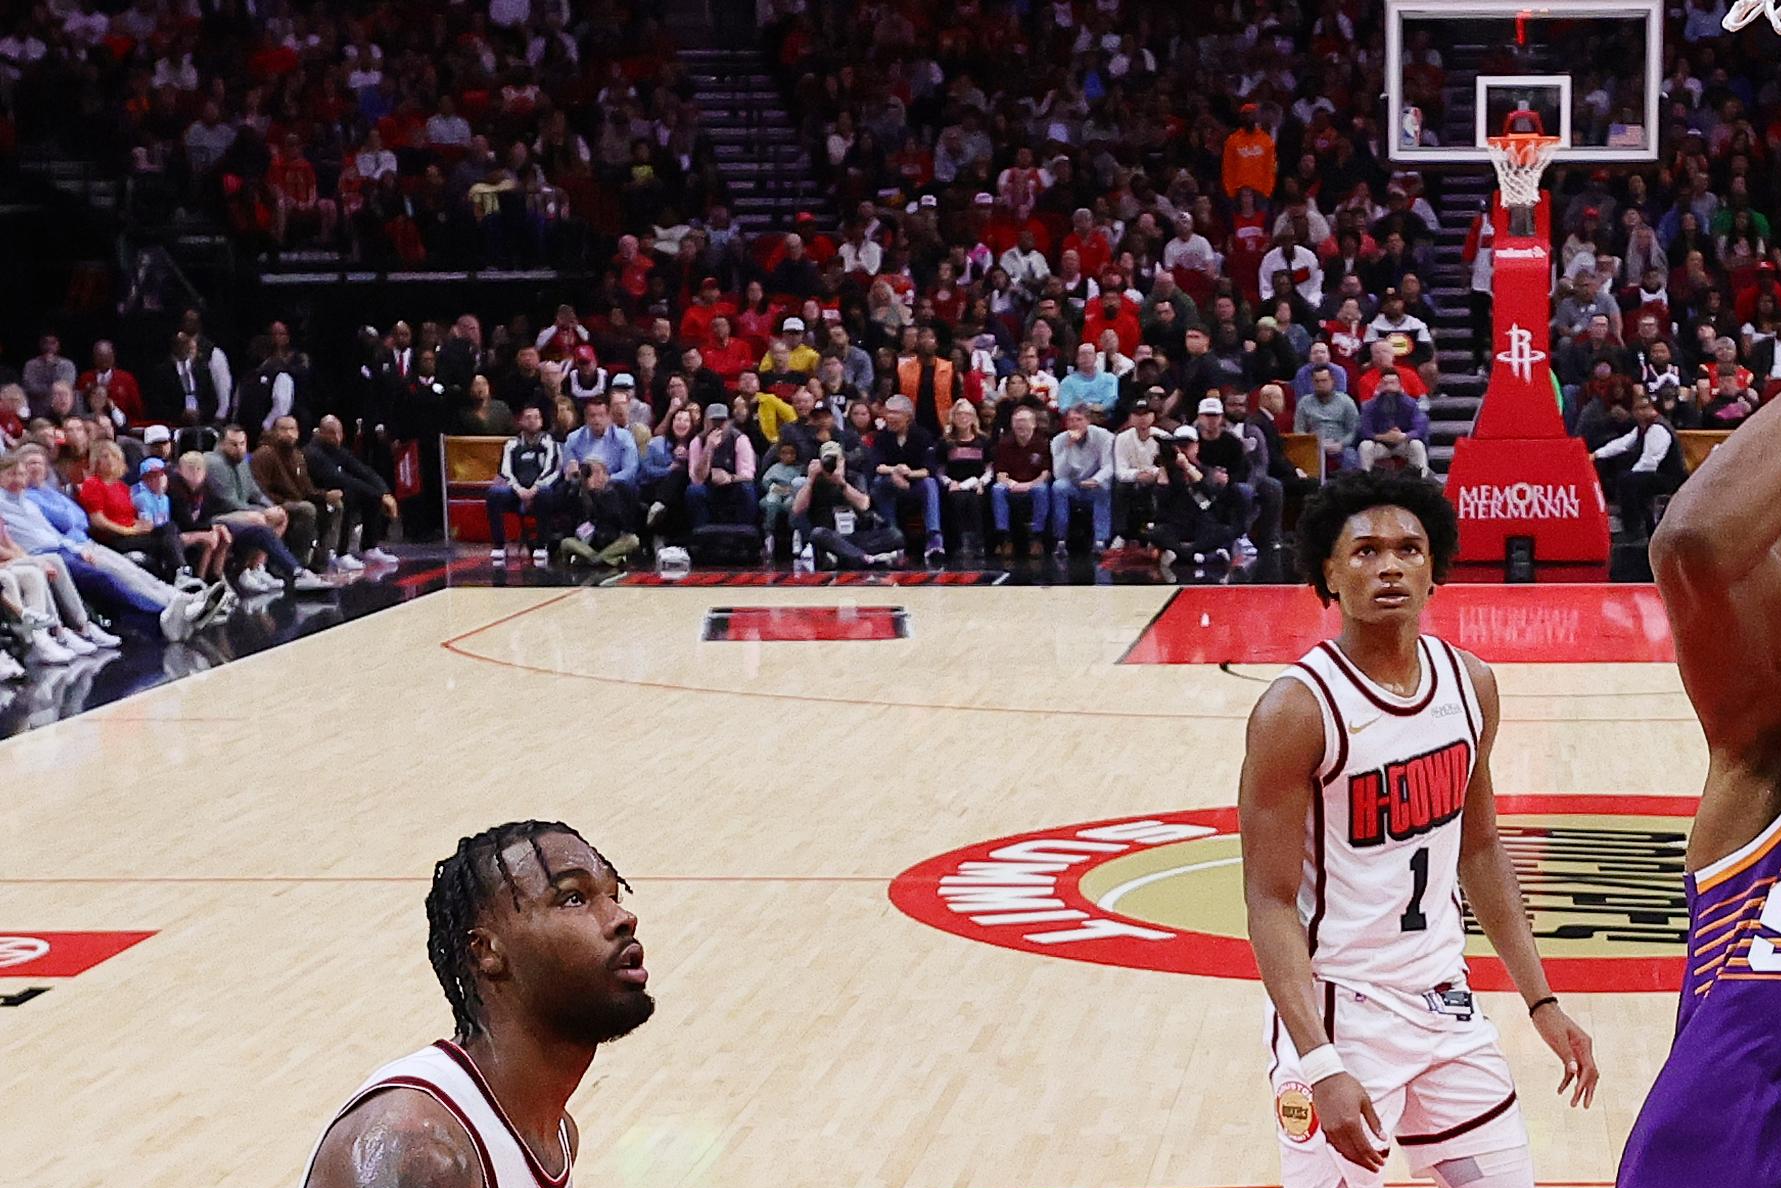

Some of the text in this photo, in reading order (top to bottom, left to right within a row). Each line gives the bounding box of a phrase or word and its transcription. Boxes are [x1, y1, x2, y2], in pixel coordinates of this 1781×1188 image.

[1458, 499, 1579, 519] HERMANN
[1459, 482, 1580, 503] MEMORIAL
[936, 820, 1219, 943] SUMMIT
[1401, 847, 1428, 931] 1
